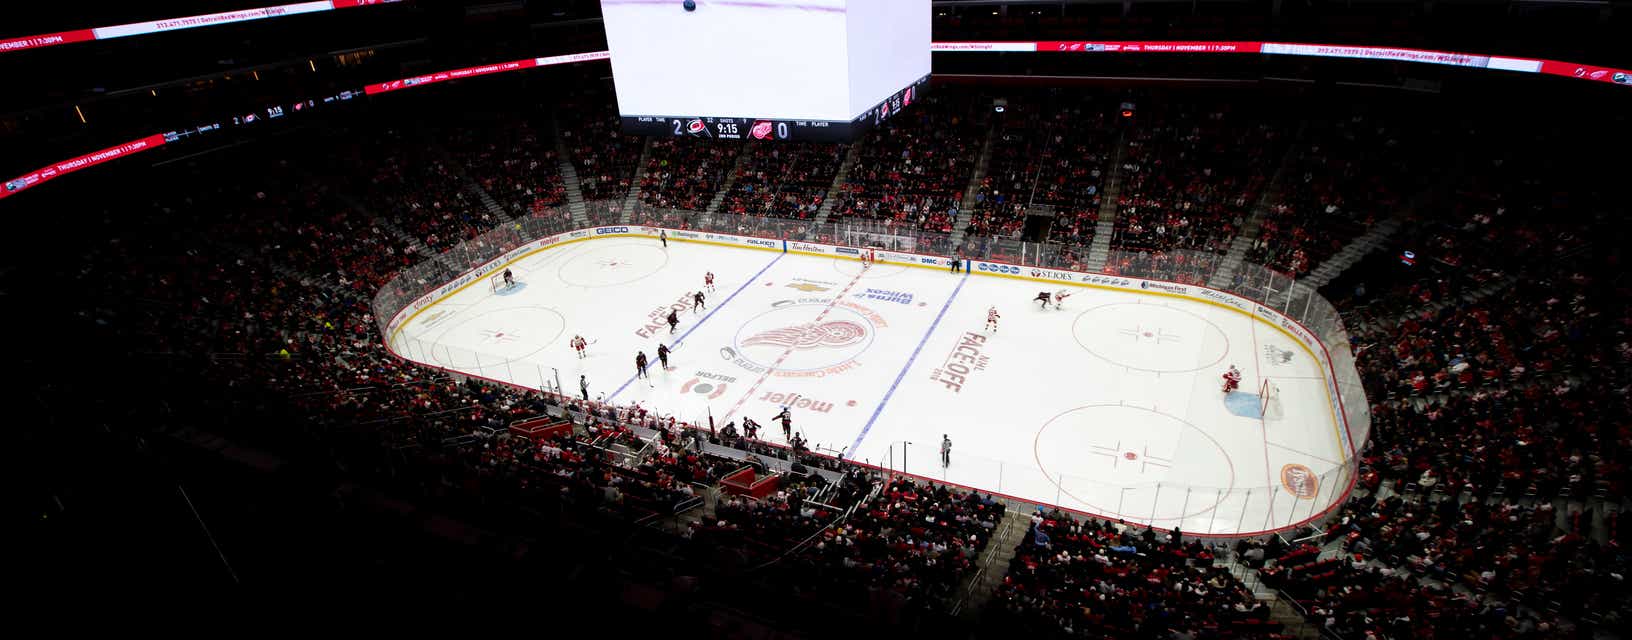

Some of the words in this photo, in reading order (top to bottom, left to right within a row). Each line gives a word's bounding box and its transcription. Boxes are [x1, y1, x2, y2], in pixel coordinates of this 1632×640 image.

[673, 119, 683, 135] 2
[717, 123, 738, 134] 9:15
[778, 122, 788, 139] 0
[597, 226, 629, 235] GEICO
[921, 257, 937, 265] DMC
[696, 371, 737, 383] BELFOR
[760, 391, 834, 413] meijer
